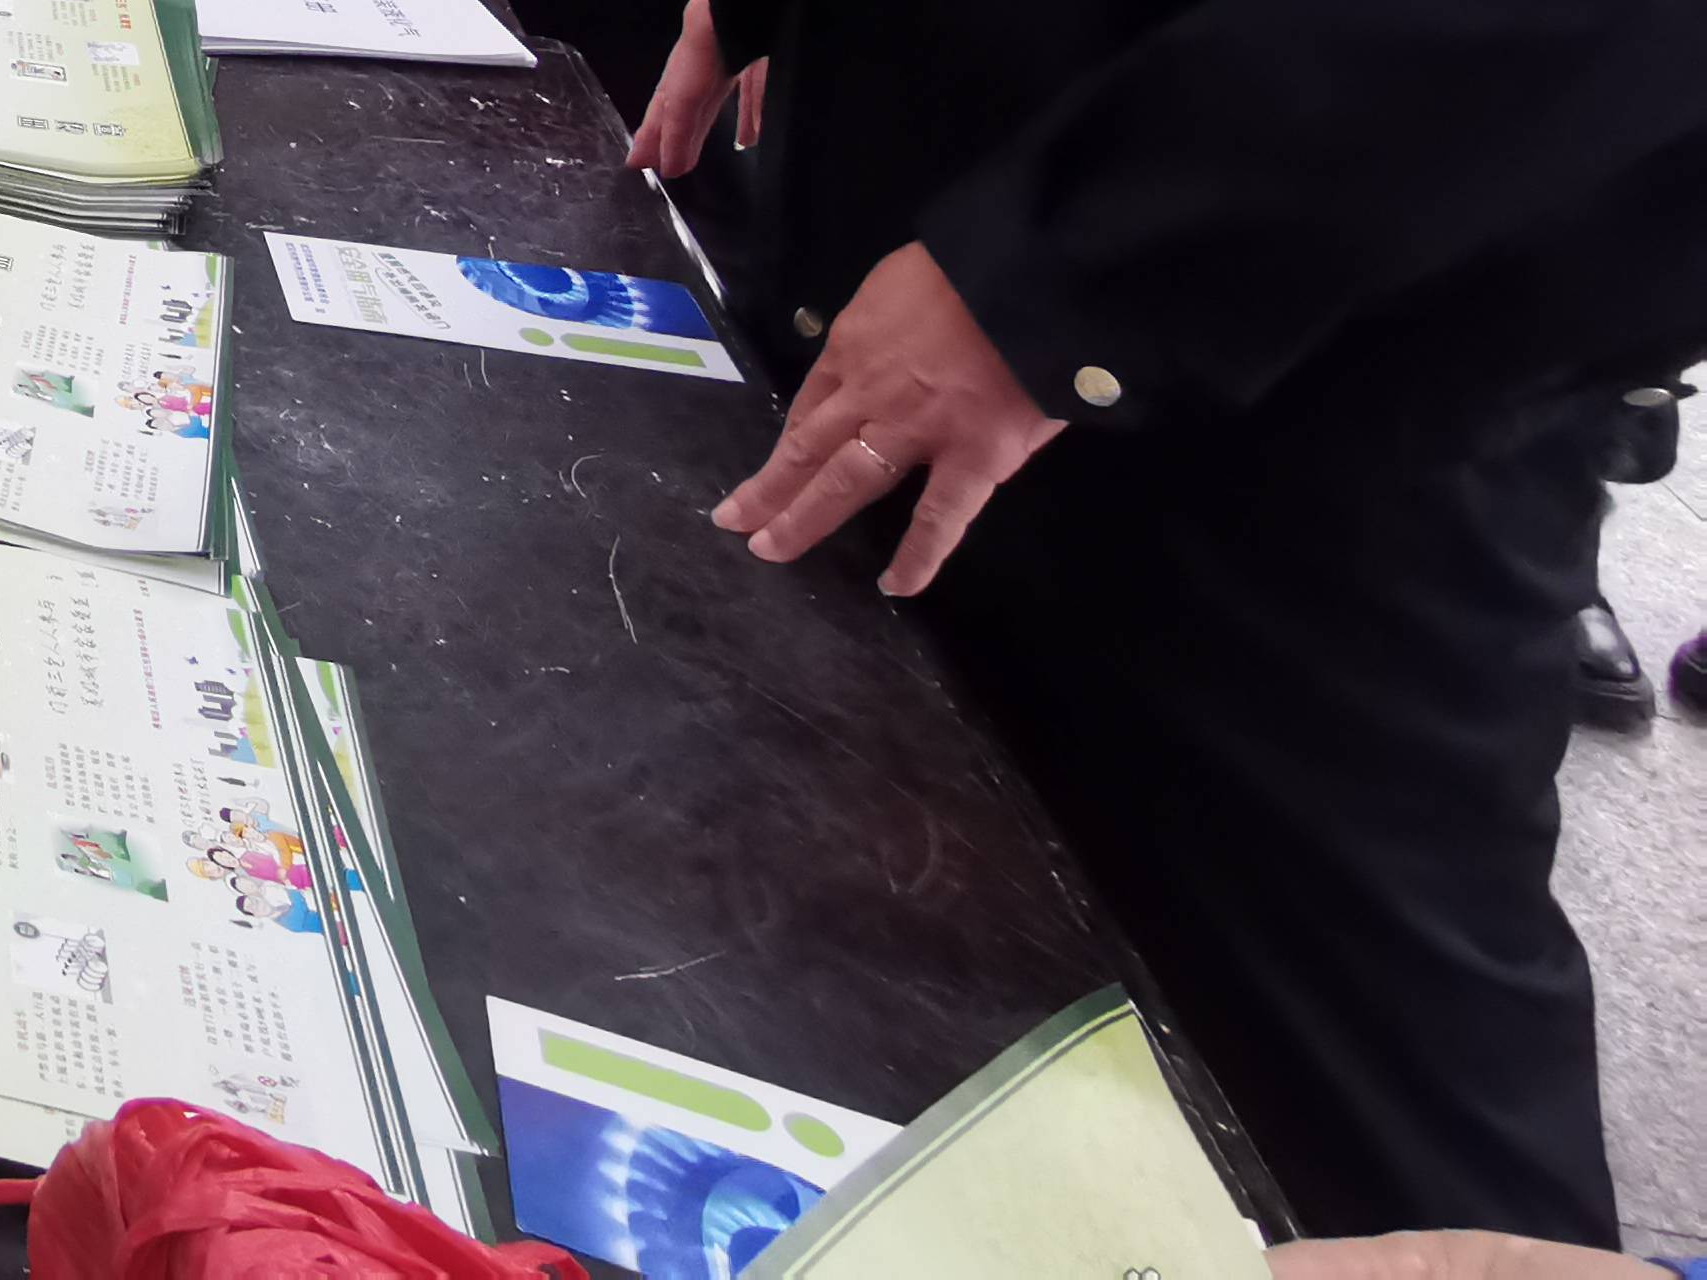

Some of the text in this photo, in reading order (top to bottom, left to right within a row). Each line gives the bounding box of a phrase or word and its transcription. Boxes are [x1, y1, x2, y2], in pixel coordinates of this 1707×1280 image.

[335, 246, 390, 325] 安全用气指南
